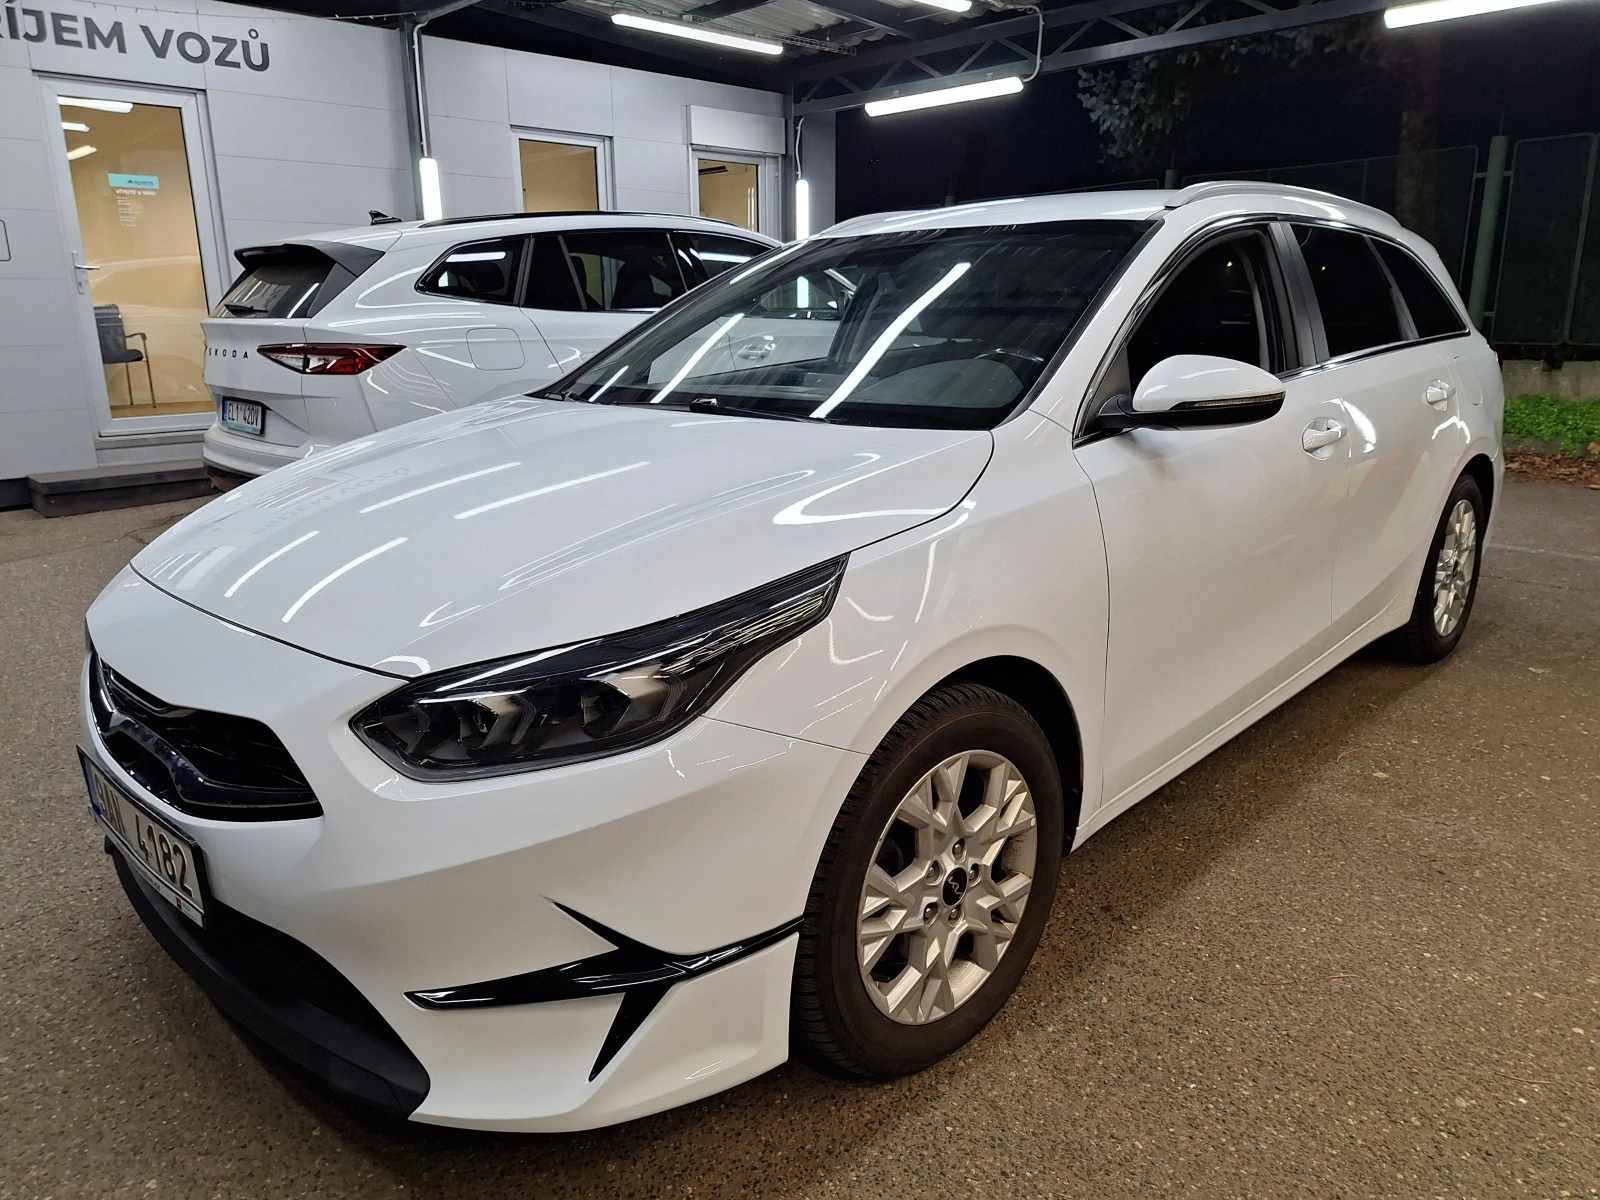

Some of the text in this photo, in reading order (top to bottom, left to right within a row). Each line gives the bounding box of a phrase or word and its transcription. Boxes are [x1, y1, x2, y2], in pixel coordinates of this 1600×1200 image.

[0, 0, 270, 72] ÍJEM VOZŮ
[135, 813, 194, 898] 4182
